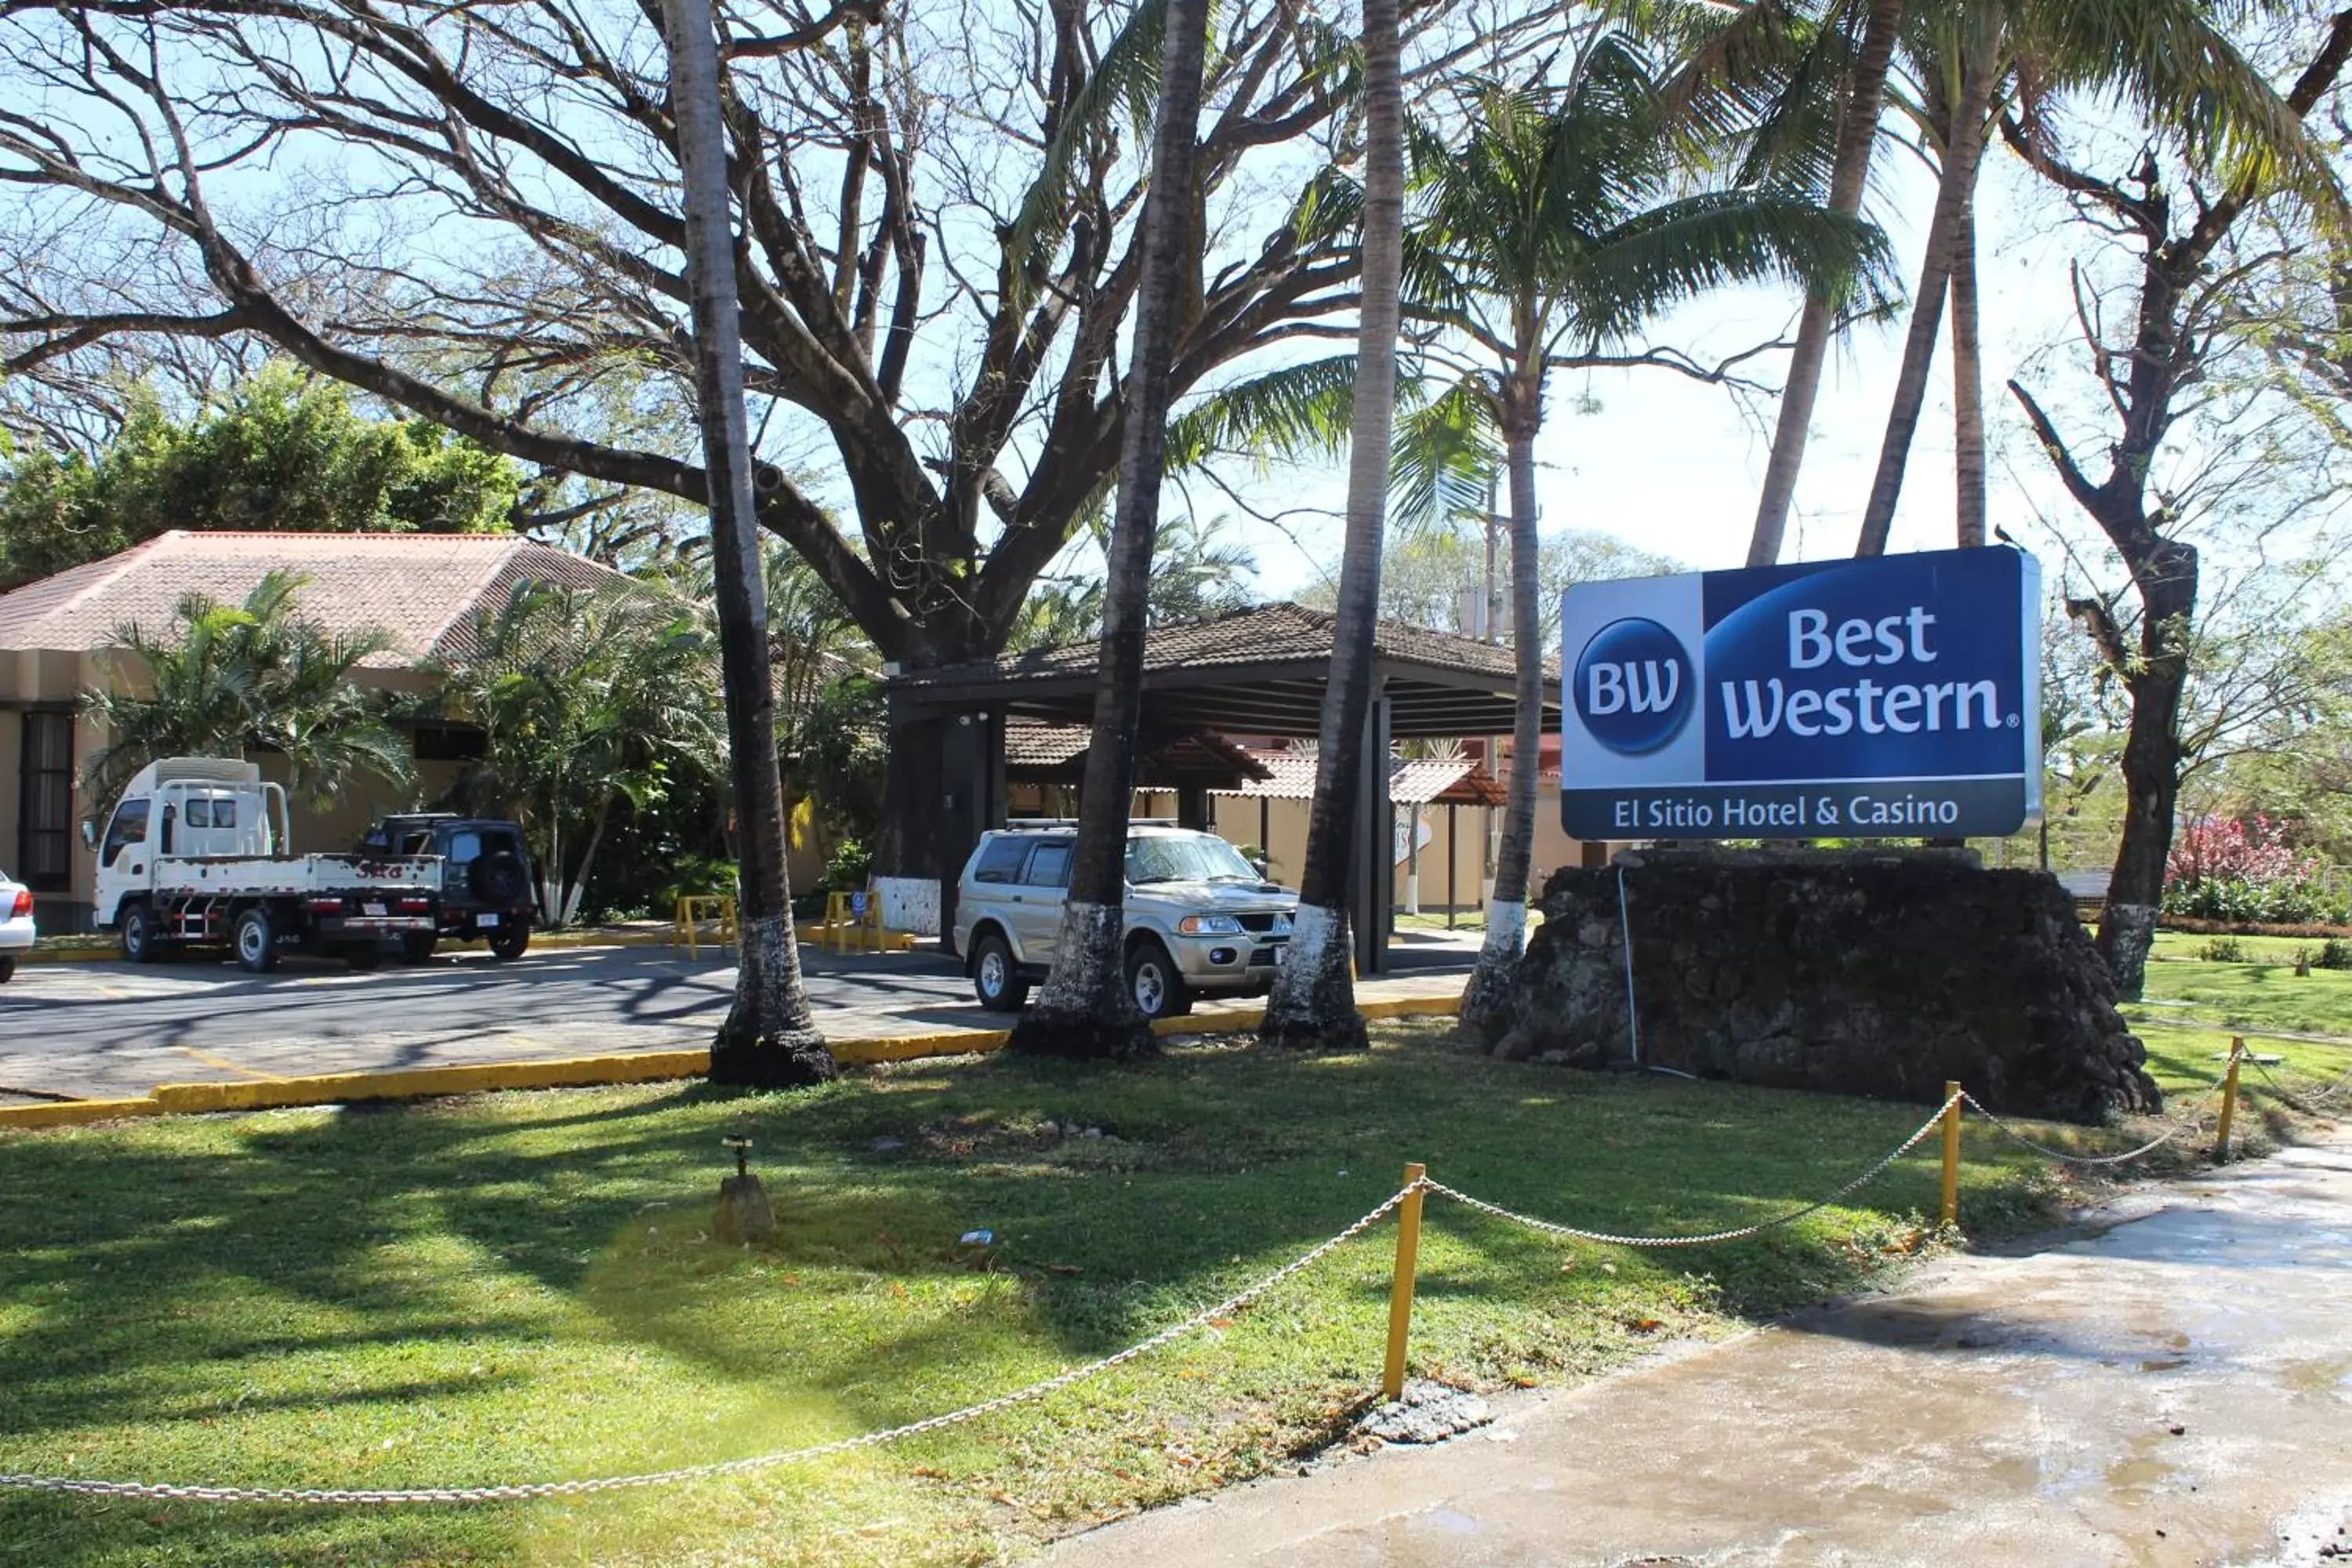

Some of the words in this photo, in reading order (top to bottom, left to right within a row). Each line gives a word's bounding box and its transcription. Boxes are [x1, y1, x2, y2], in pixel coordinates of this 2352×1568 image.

[1788, 606, 1938, 669] Best
[1588, 658, 1679, 715] BW
[1615, 799, 1639, 827] El
[1649, 798, 1713, 827] Sitio
[1724, 796, 1806, 826] Hotel
[1816, 797, 1839, 825] &
[1849, 793, 1958, 824] Casino
